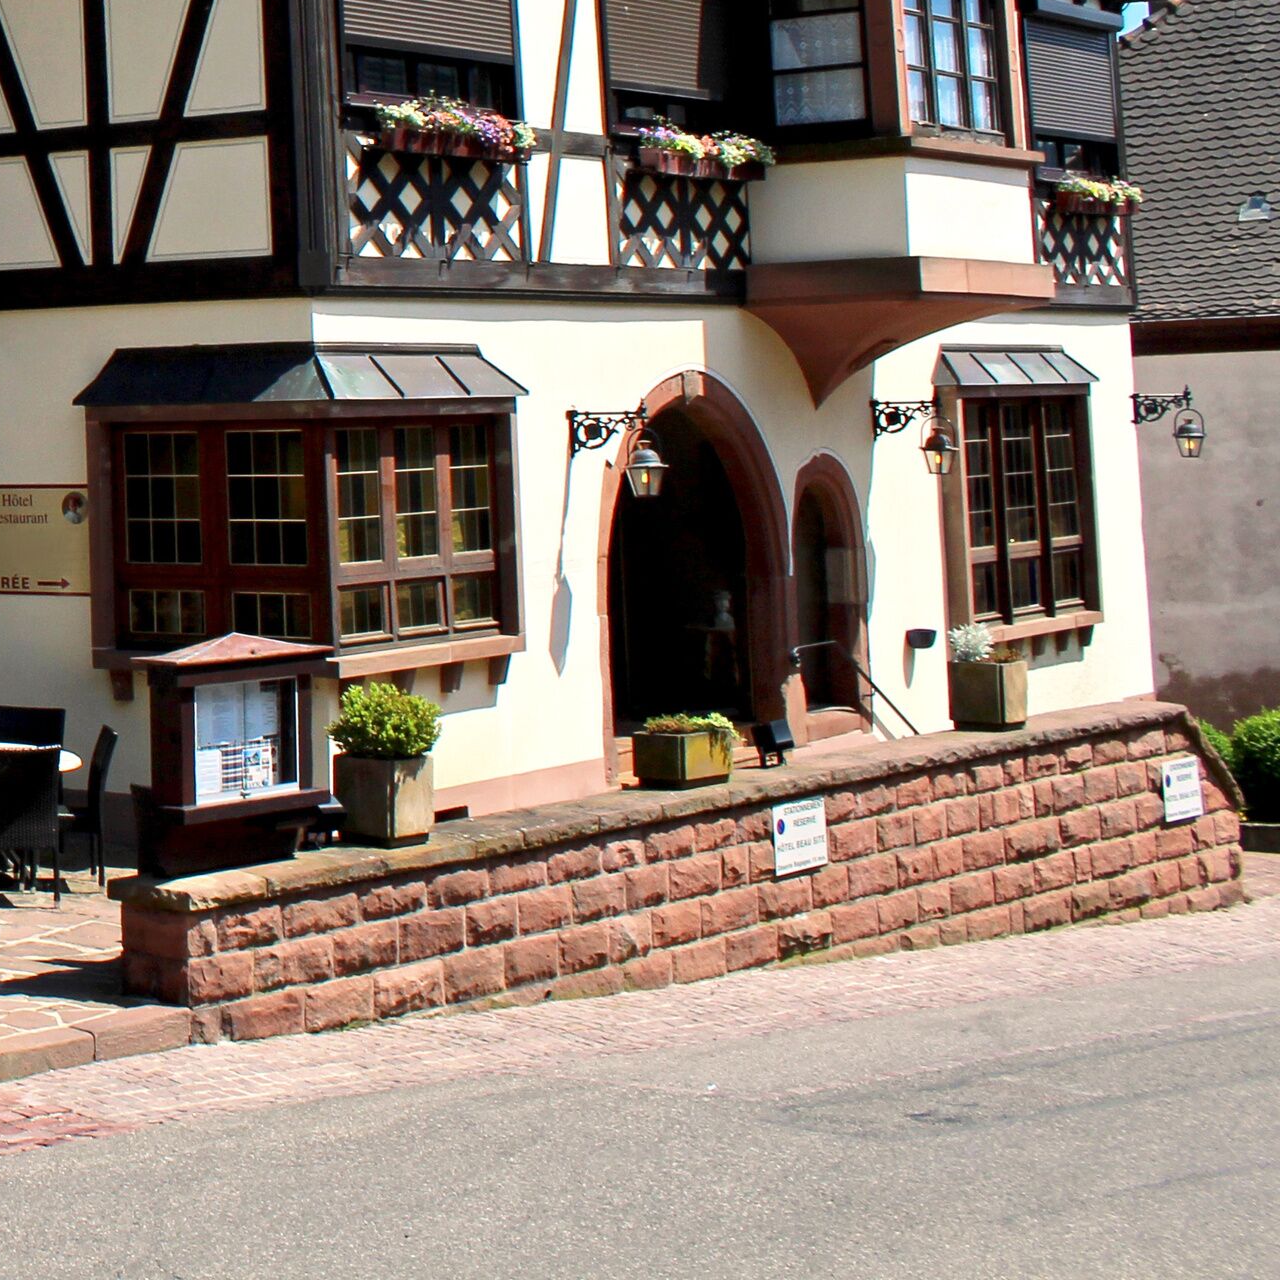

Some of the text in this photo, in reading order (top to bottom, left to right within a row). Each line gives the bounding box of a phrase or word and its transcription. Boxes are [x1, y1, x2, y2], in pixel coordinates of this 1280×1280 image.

[2, 494, 33, 507] Hôtel
[796, 838, 812, 849] BEAU
[813, 835, 825, 845] SITE
